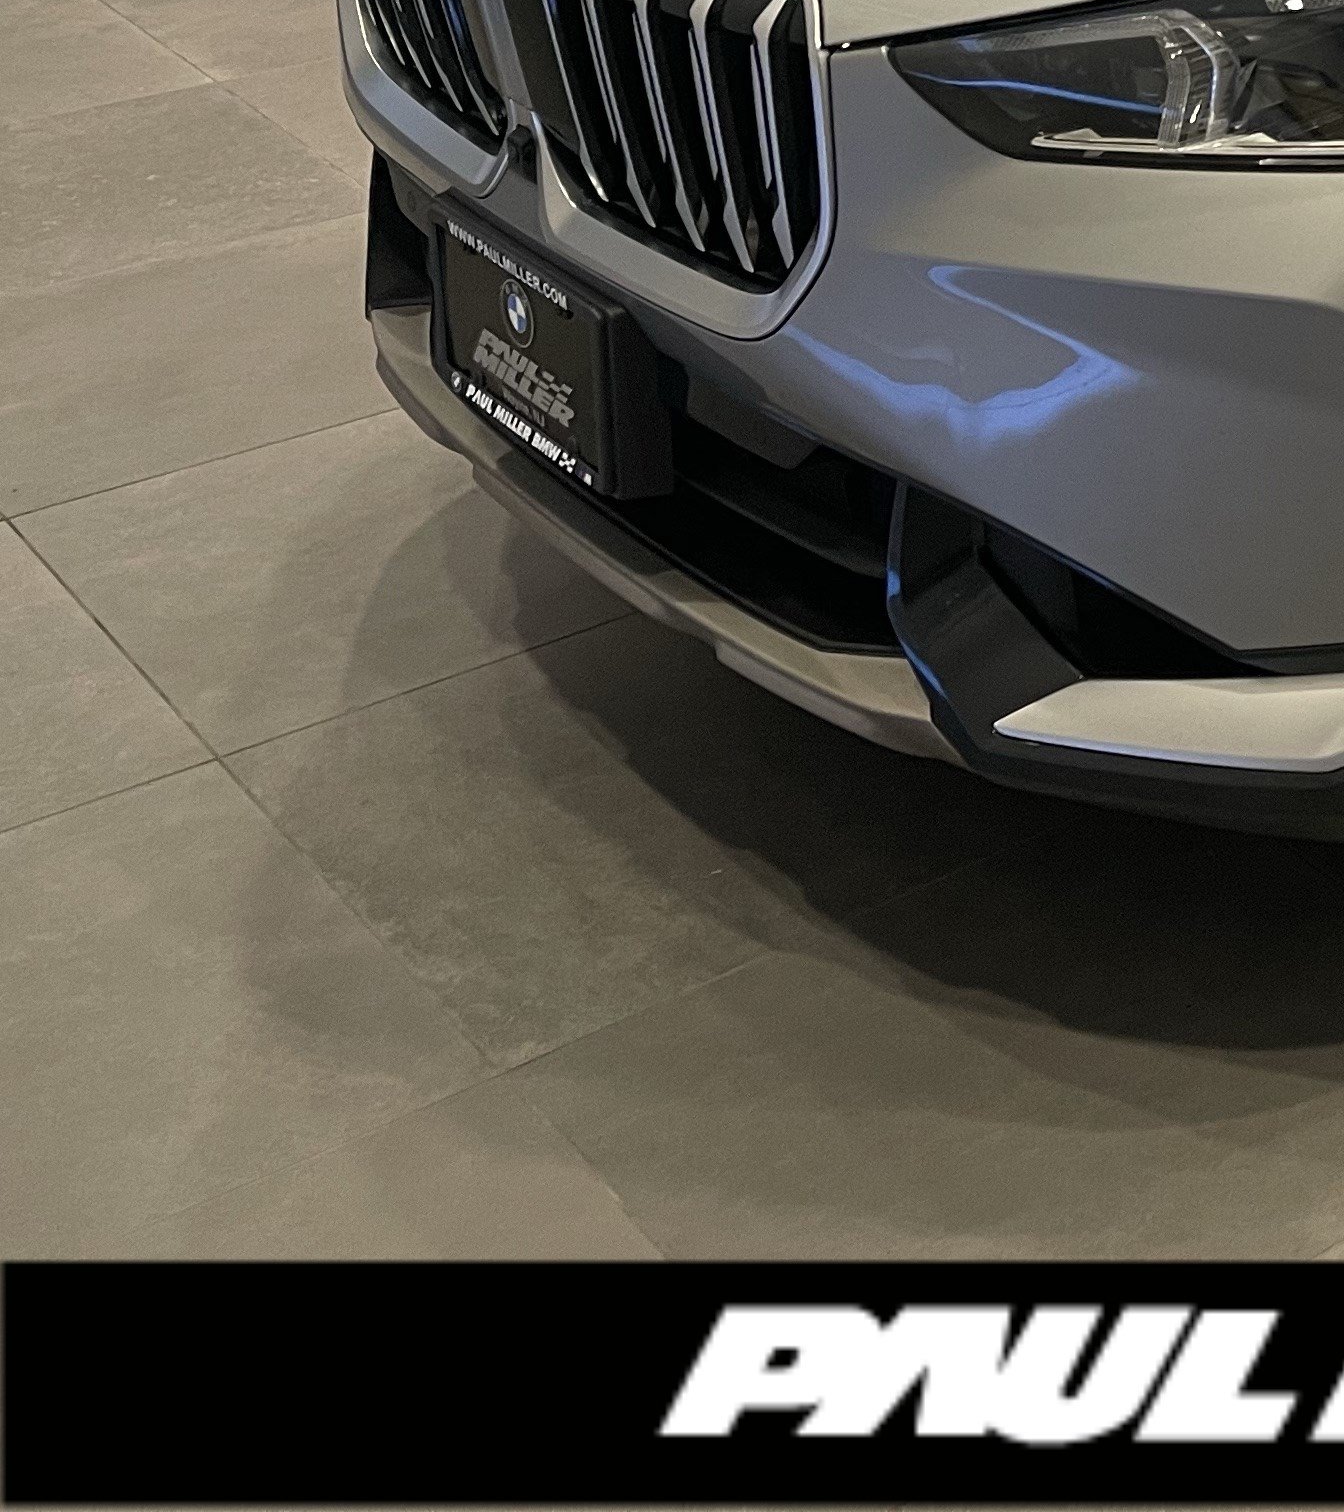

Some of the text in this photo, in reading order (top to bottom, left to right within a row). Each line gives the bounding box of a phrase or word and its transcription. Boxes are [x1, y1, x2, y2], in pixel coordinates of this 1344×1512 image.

[474, 345, 575, 428] MILLER
[478, 327, 540, 382] PAUL
[465, 383, 493, 413] PAUL
[493, 406, 533, 442] MILLER
[531, 431, 562, 462] BMW
